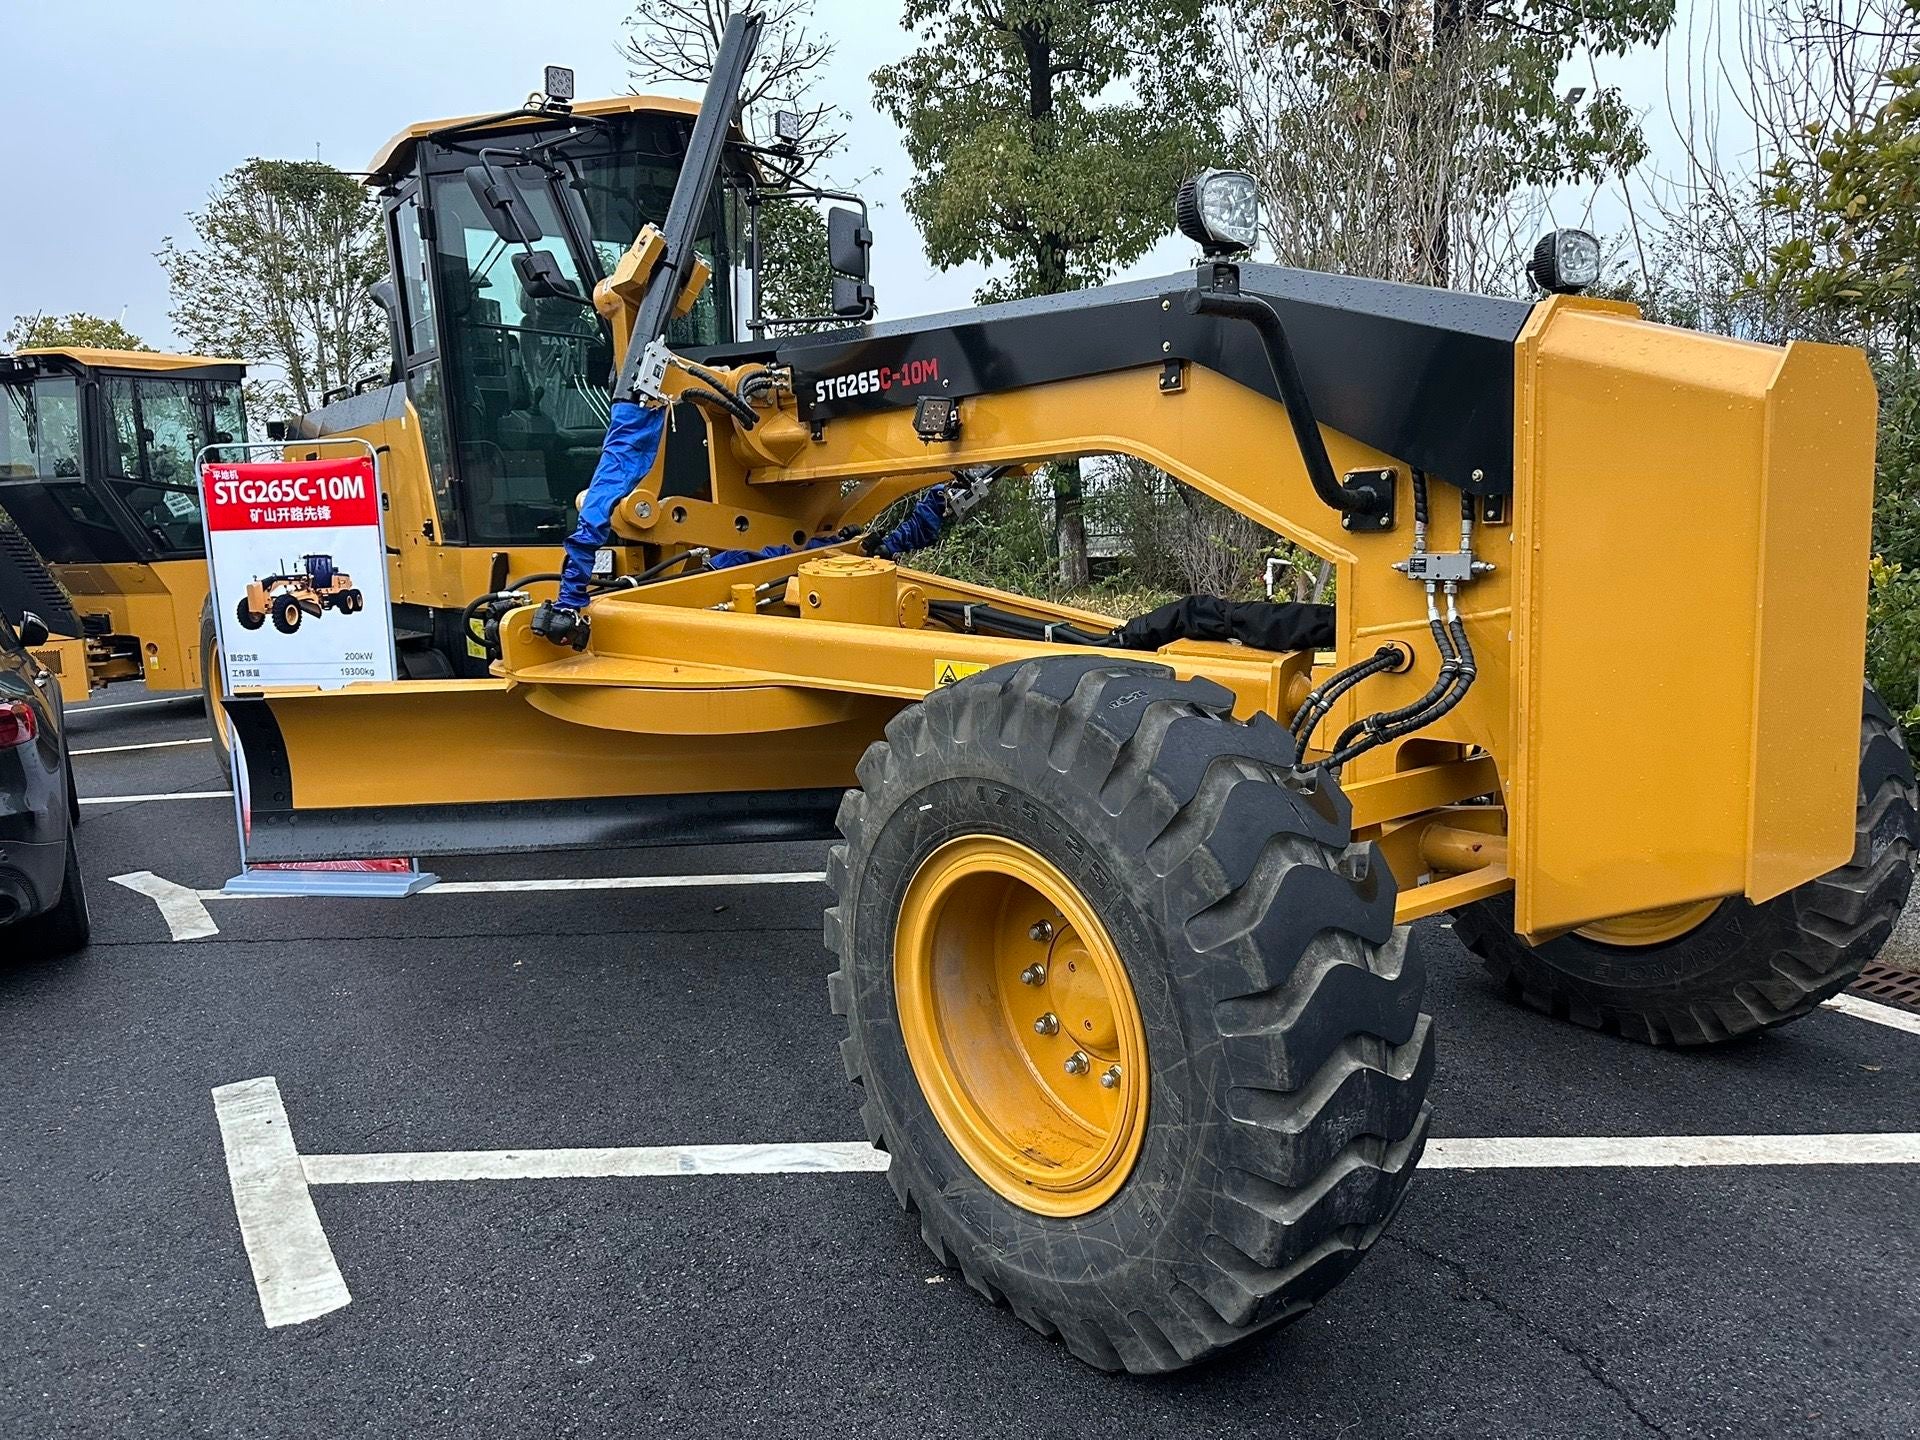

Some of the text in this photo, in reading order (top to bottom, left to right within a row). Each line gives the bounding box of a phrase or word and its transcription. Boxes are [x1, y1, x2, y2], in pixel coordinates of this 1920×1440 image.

[816, 358, 938, 402] STG265C-10M
[212, 470, 239, 480] 平地机
[214, 476, 365, 505] STG265C-10M
[249, 506, 332, 523] 矿山开路先锋
[230, 653, 258, 662] 额定功率
[345, 652, 373, 660] 200kW
[231, 669, 260, 678] 工作质量
[340, 668, 375, 677] 19300kg
[976, 785, 1110, 889] 17.5-25
